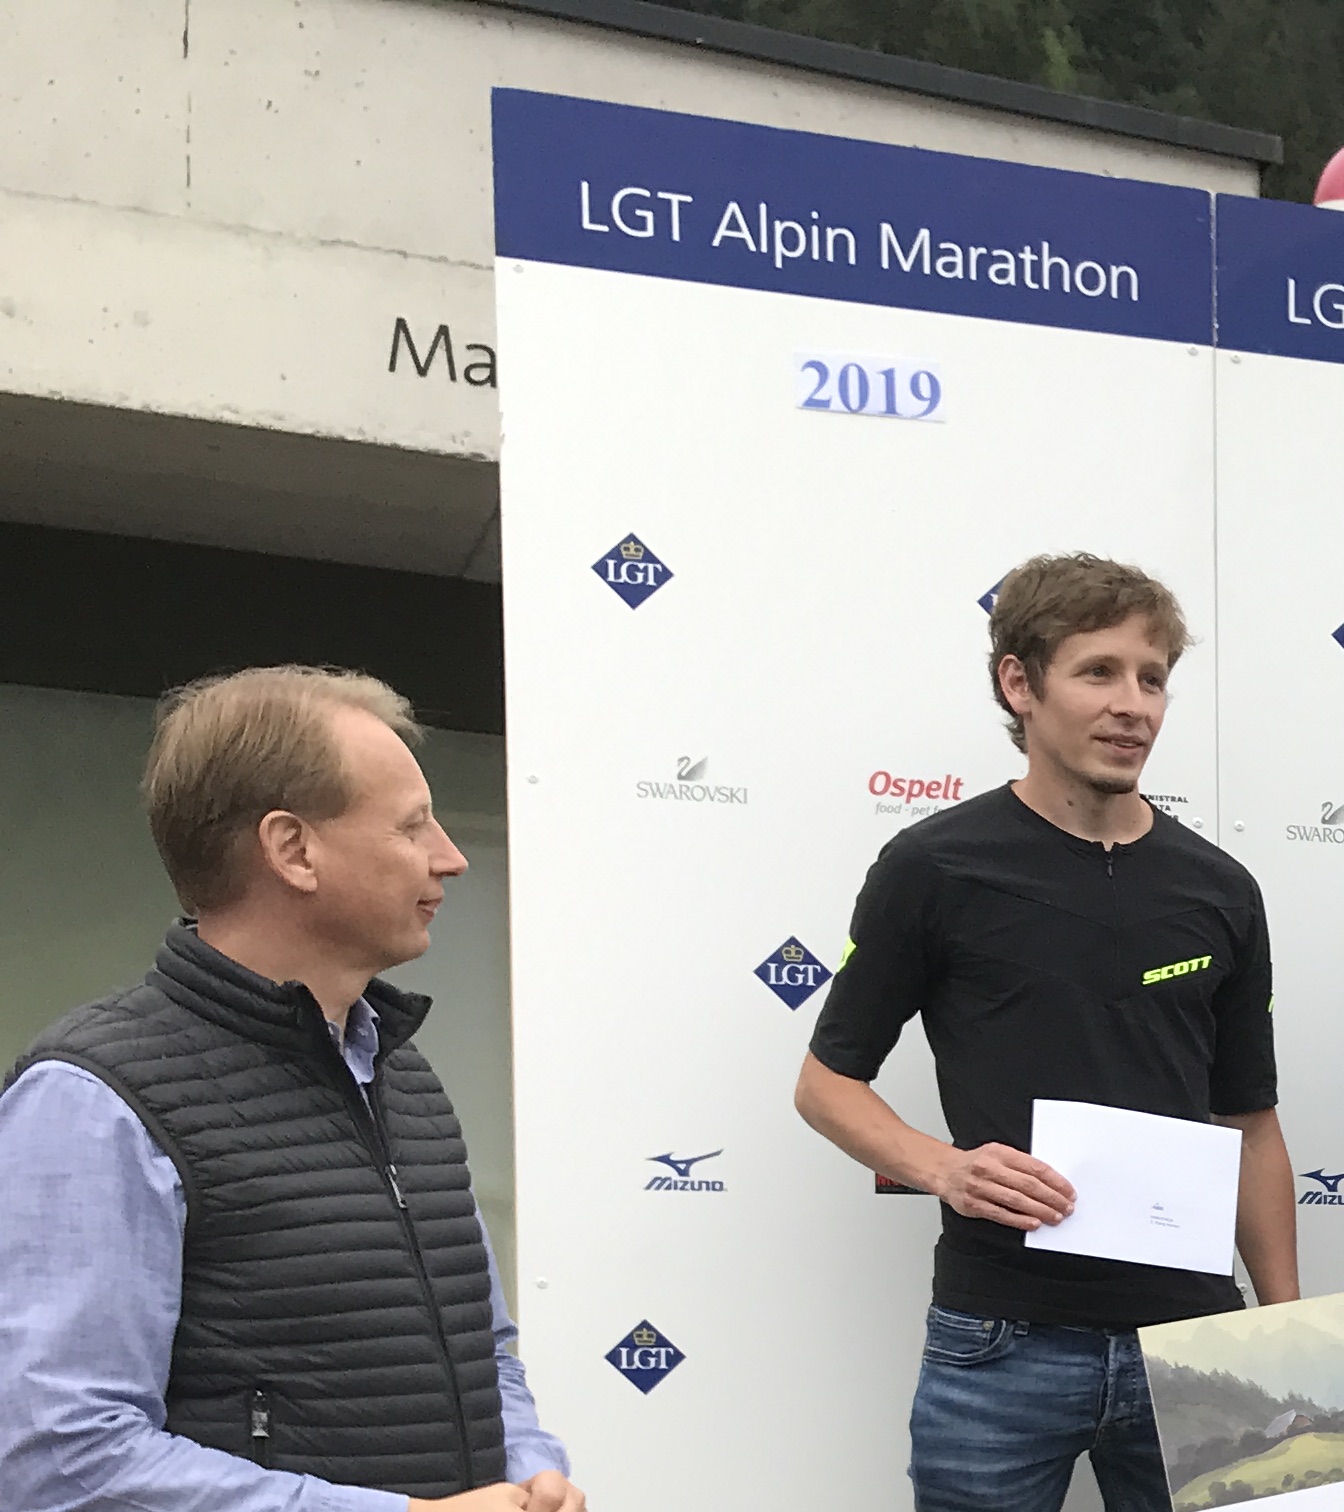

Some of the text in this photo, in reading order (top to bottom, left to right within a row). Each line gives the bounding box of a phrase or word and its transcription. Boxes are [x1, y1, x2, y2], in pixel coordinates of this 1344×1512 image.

[581, 180, 1141, 303] LGT Alpin Marathon
[800, 359, 942, 420] 2019
[605, 559, 662, 587] LGT
[636, 781, 748, 804] SWAROVSKI
[869, 770, 965, 804] Ospelt
[875, 802, 902, 815] food
[767, 961, 821, 988] LGT
[1142, 955, 1212, 985] SCOTT
[643, 1177, 728, 1192] MIZUNO
[618, 1347, 674, 1370] LGT
